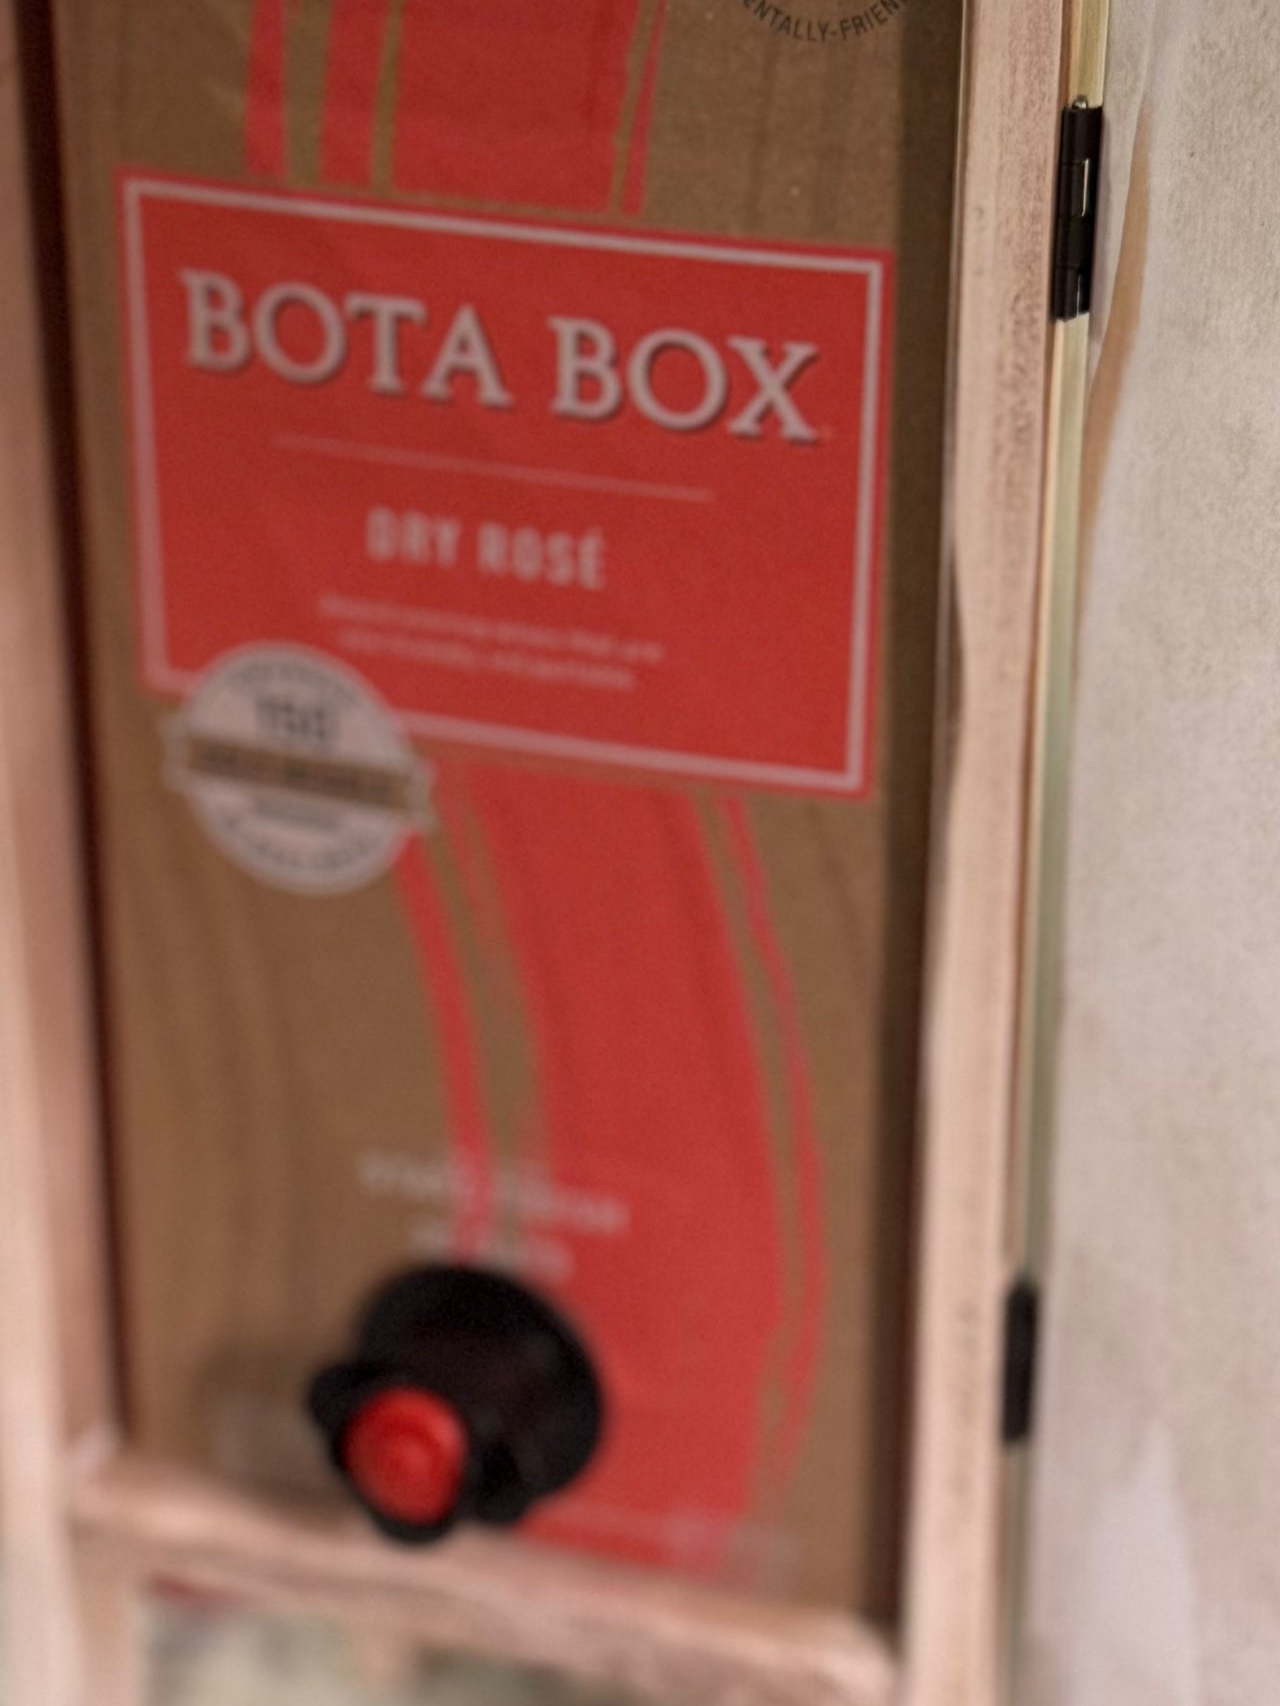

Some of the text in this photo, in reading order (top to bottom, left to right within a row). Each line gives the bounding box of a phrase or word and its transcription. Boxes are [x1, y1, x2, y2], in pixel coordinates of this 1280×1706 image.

[179, 266, 821, 444] BOTA BOX
[366, 505, 606, 591] DRY ROSÉ
